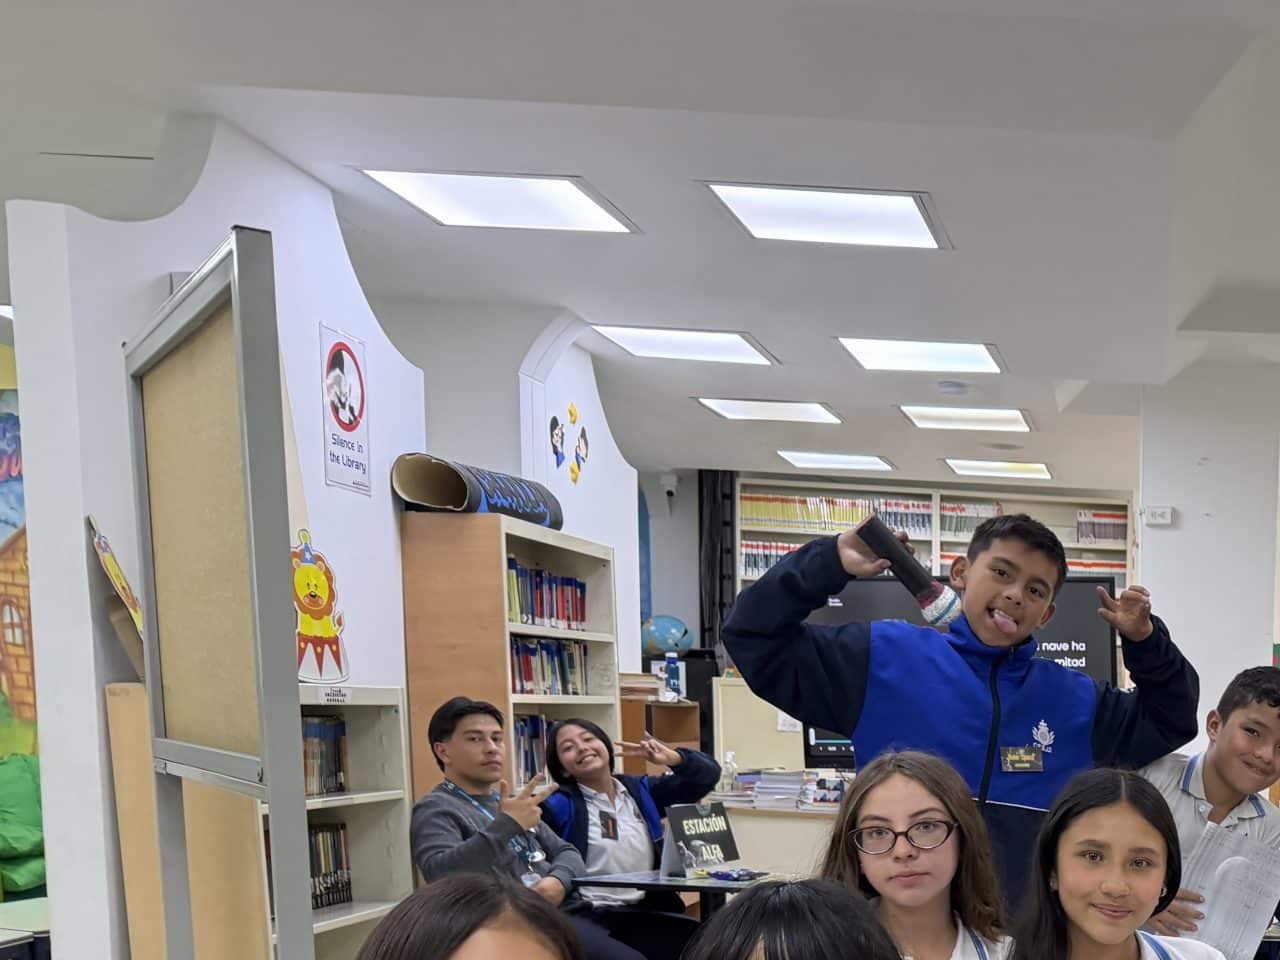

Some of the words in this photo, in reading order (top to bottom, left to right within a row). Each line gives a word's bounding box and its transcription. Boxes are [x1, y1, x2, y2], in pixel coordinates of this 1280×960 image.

[329, 450, 341, 464] the
[341, 454, 367, 474] Library
[1041, 641, 1069, 652] nave
[1071, 640, 1086, 651] ha
[682, 813, 727, 835] ESTACIÓN
